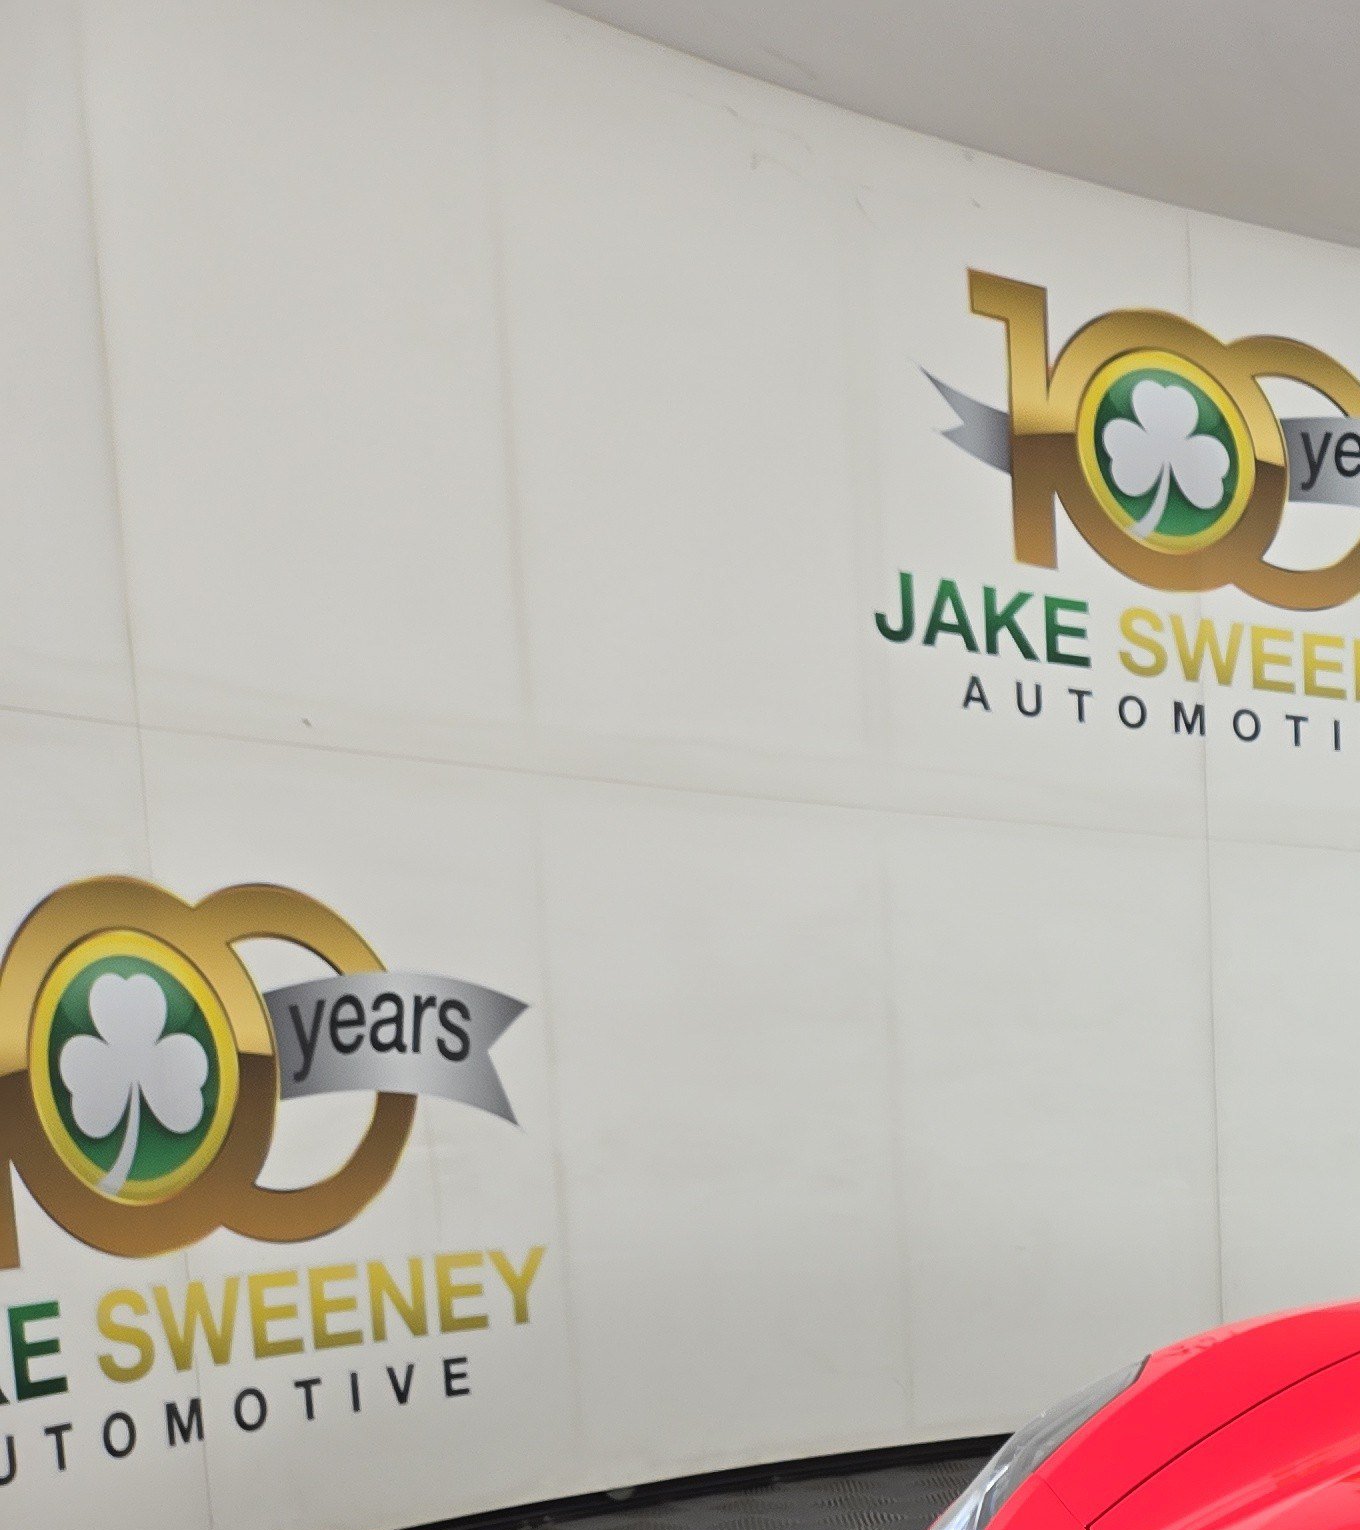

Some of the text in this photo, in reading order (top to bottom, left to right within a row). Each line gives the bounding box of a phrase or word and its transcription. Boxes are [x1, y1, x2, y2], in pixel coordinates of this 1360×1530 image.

[873, 570, 1092, 668] JAKE
[288, 992, 471, 1081] years
[95, 1245, 547, 1383] SWEENEY
[0, 1357, 470, 1486] UTOMOTIVE
